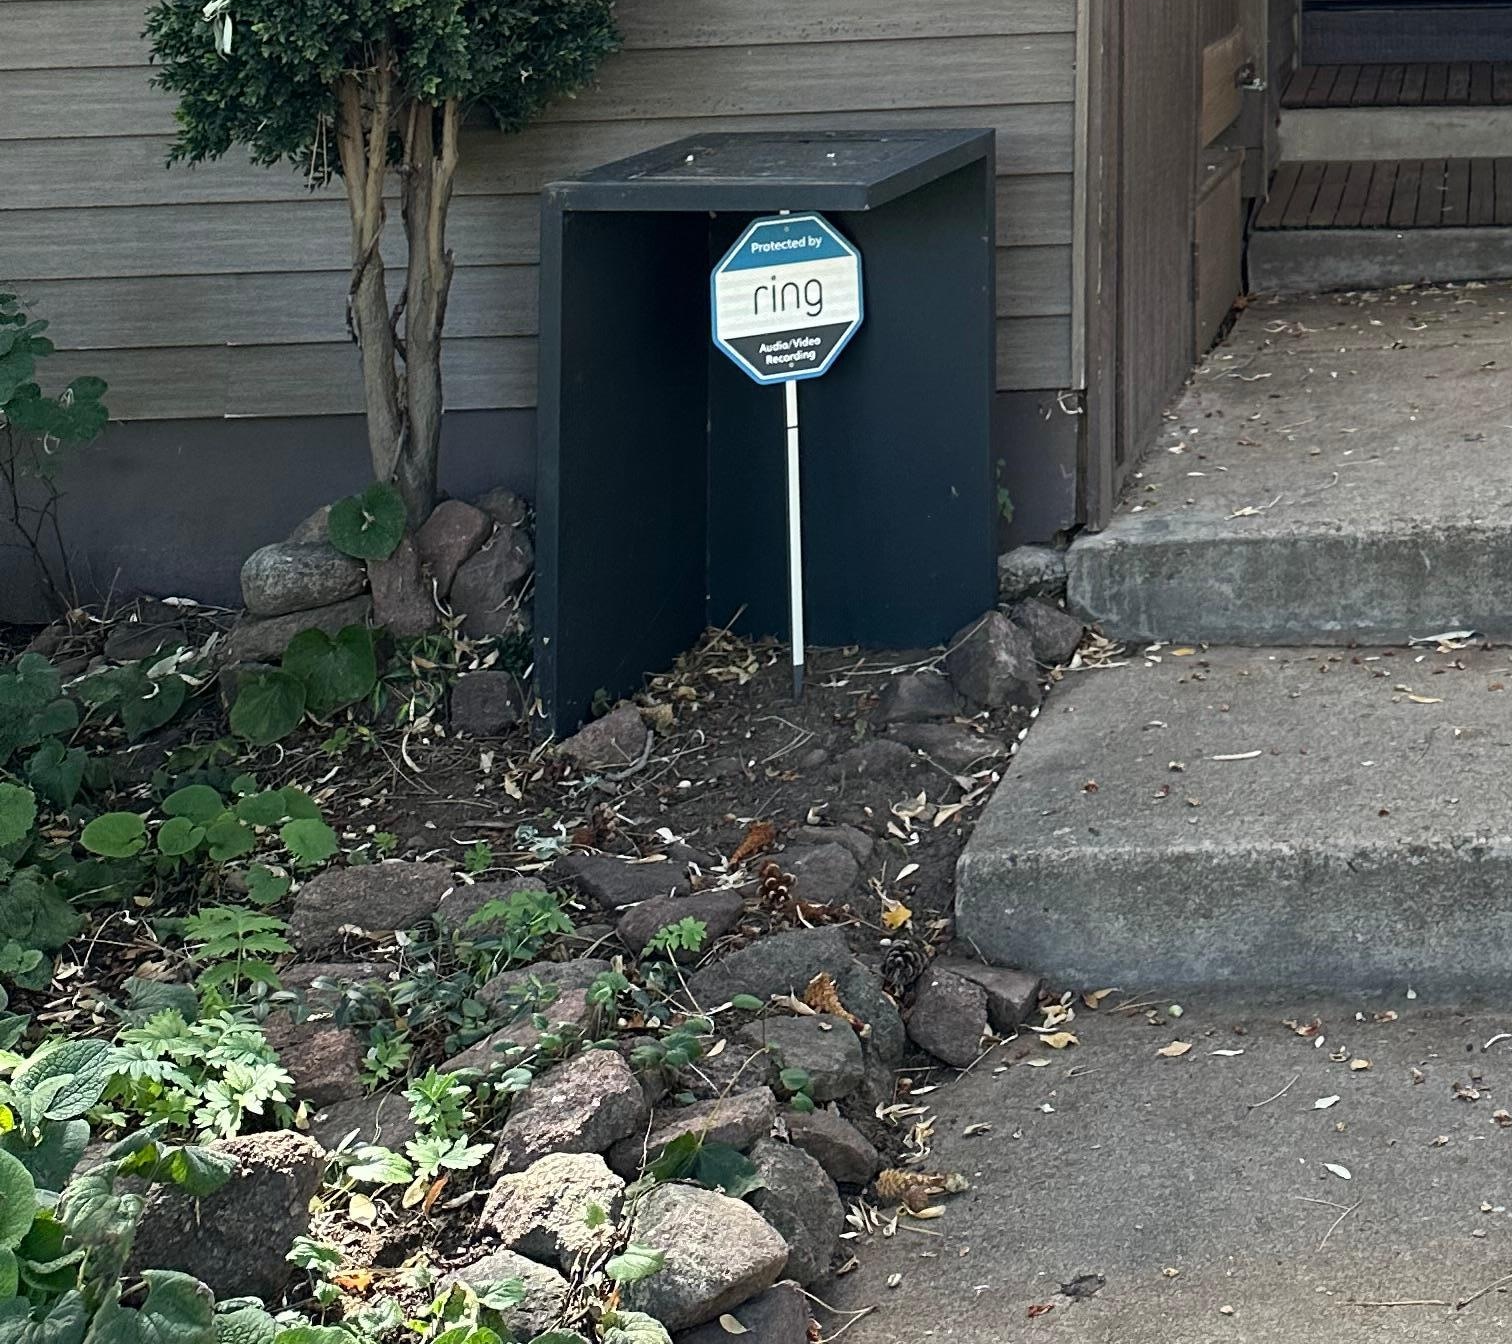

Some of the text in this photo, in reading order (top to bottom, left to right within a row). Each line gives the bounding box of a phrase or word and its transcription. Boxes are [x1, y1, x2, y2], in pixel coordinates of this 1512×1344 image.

[750, 235, 822, 254] Protected by
[754, 275, 824, 317] ring
[759, 337, 821, 353] Audio/Video
[765, 350, 816, 365] Recording
